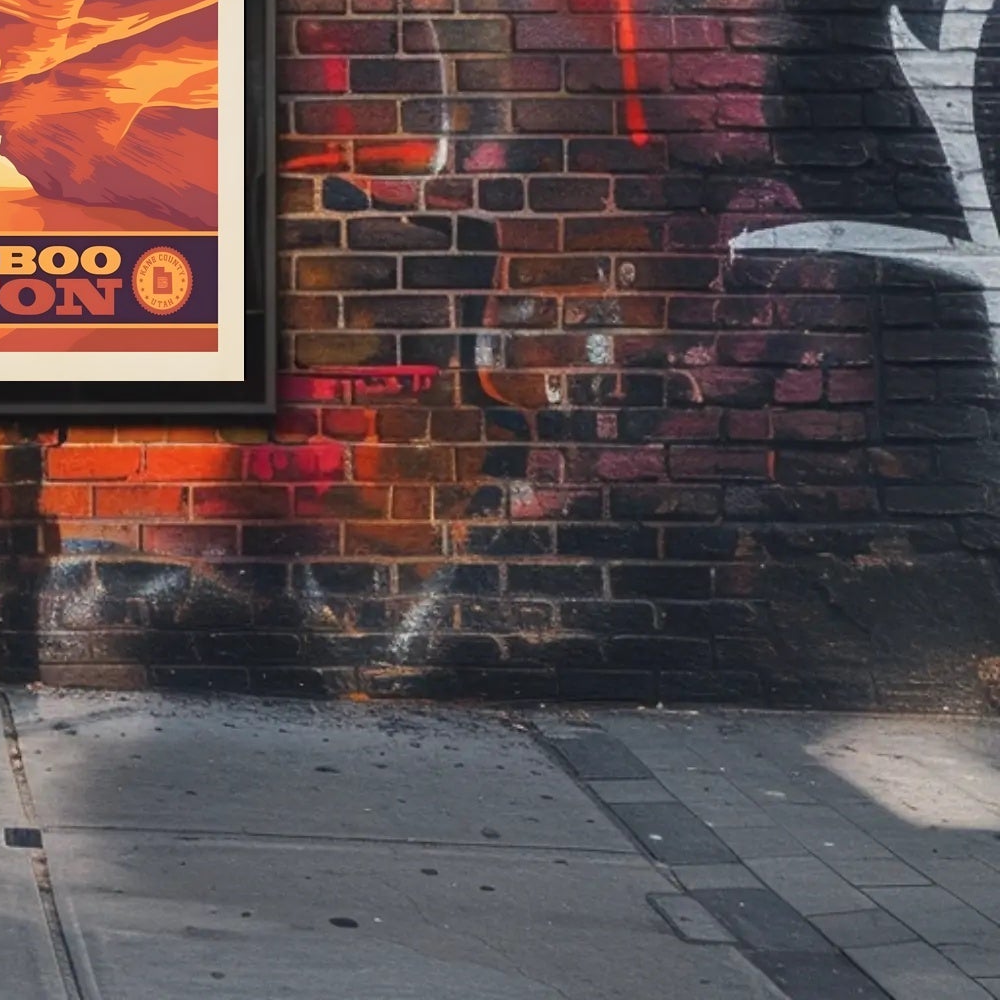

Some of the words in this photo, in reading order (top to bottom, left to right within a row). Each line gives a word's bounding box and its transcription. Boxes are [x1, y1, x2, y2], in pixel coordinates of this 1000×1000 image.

[140, 255, 157, 276] KANE
[158, 254, 186, 276] COUNTY
[150, 298, 174, 308] UTAH
